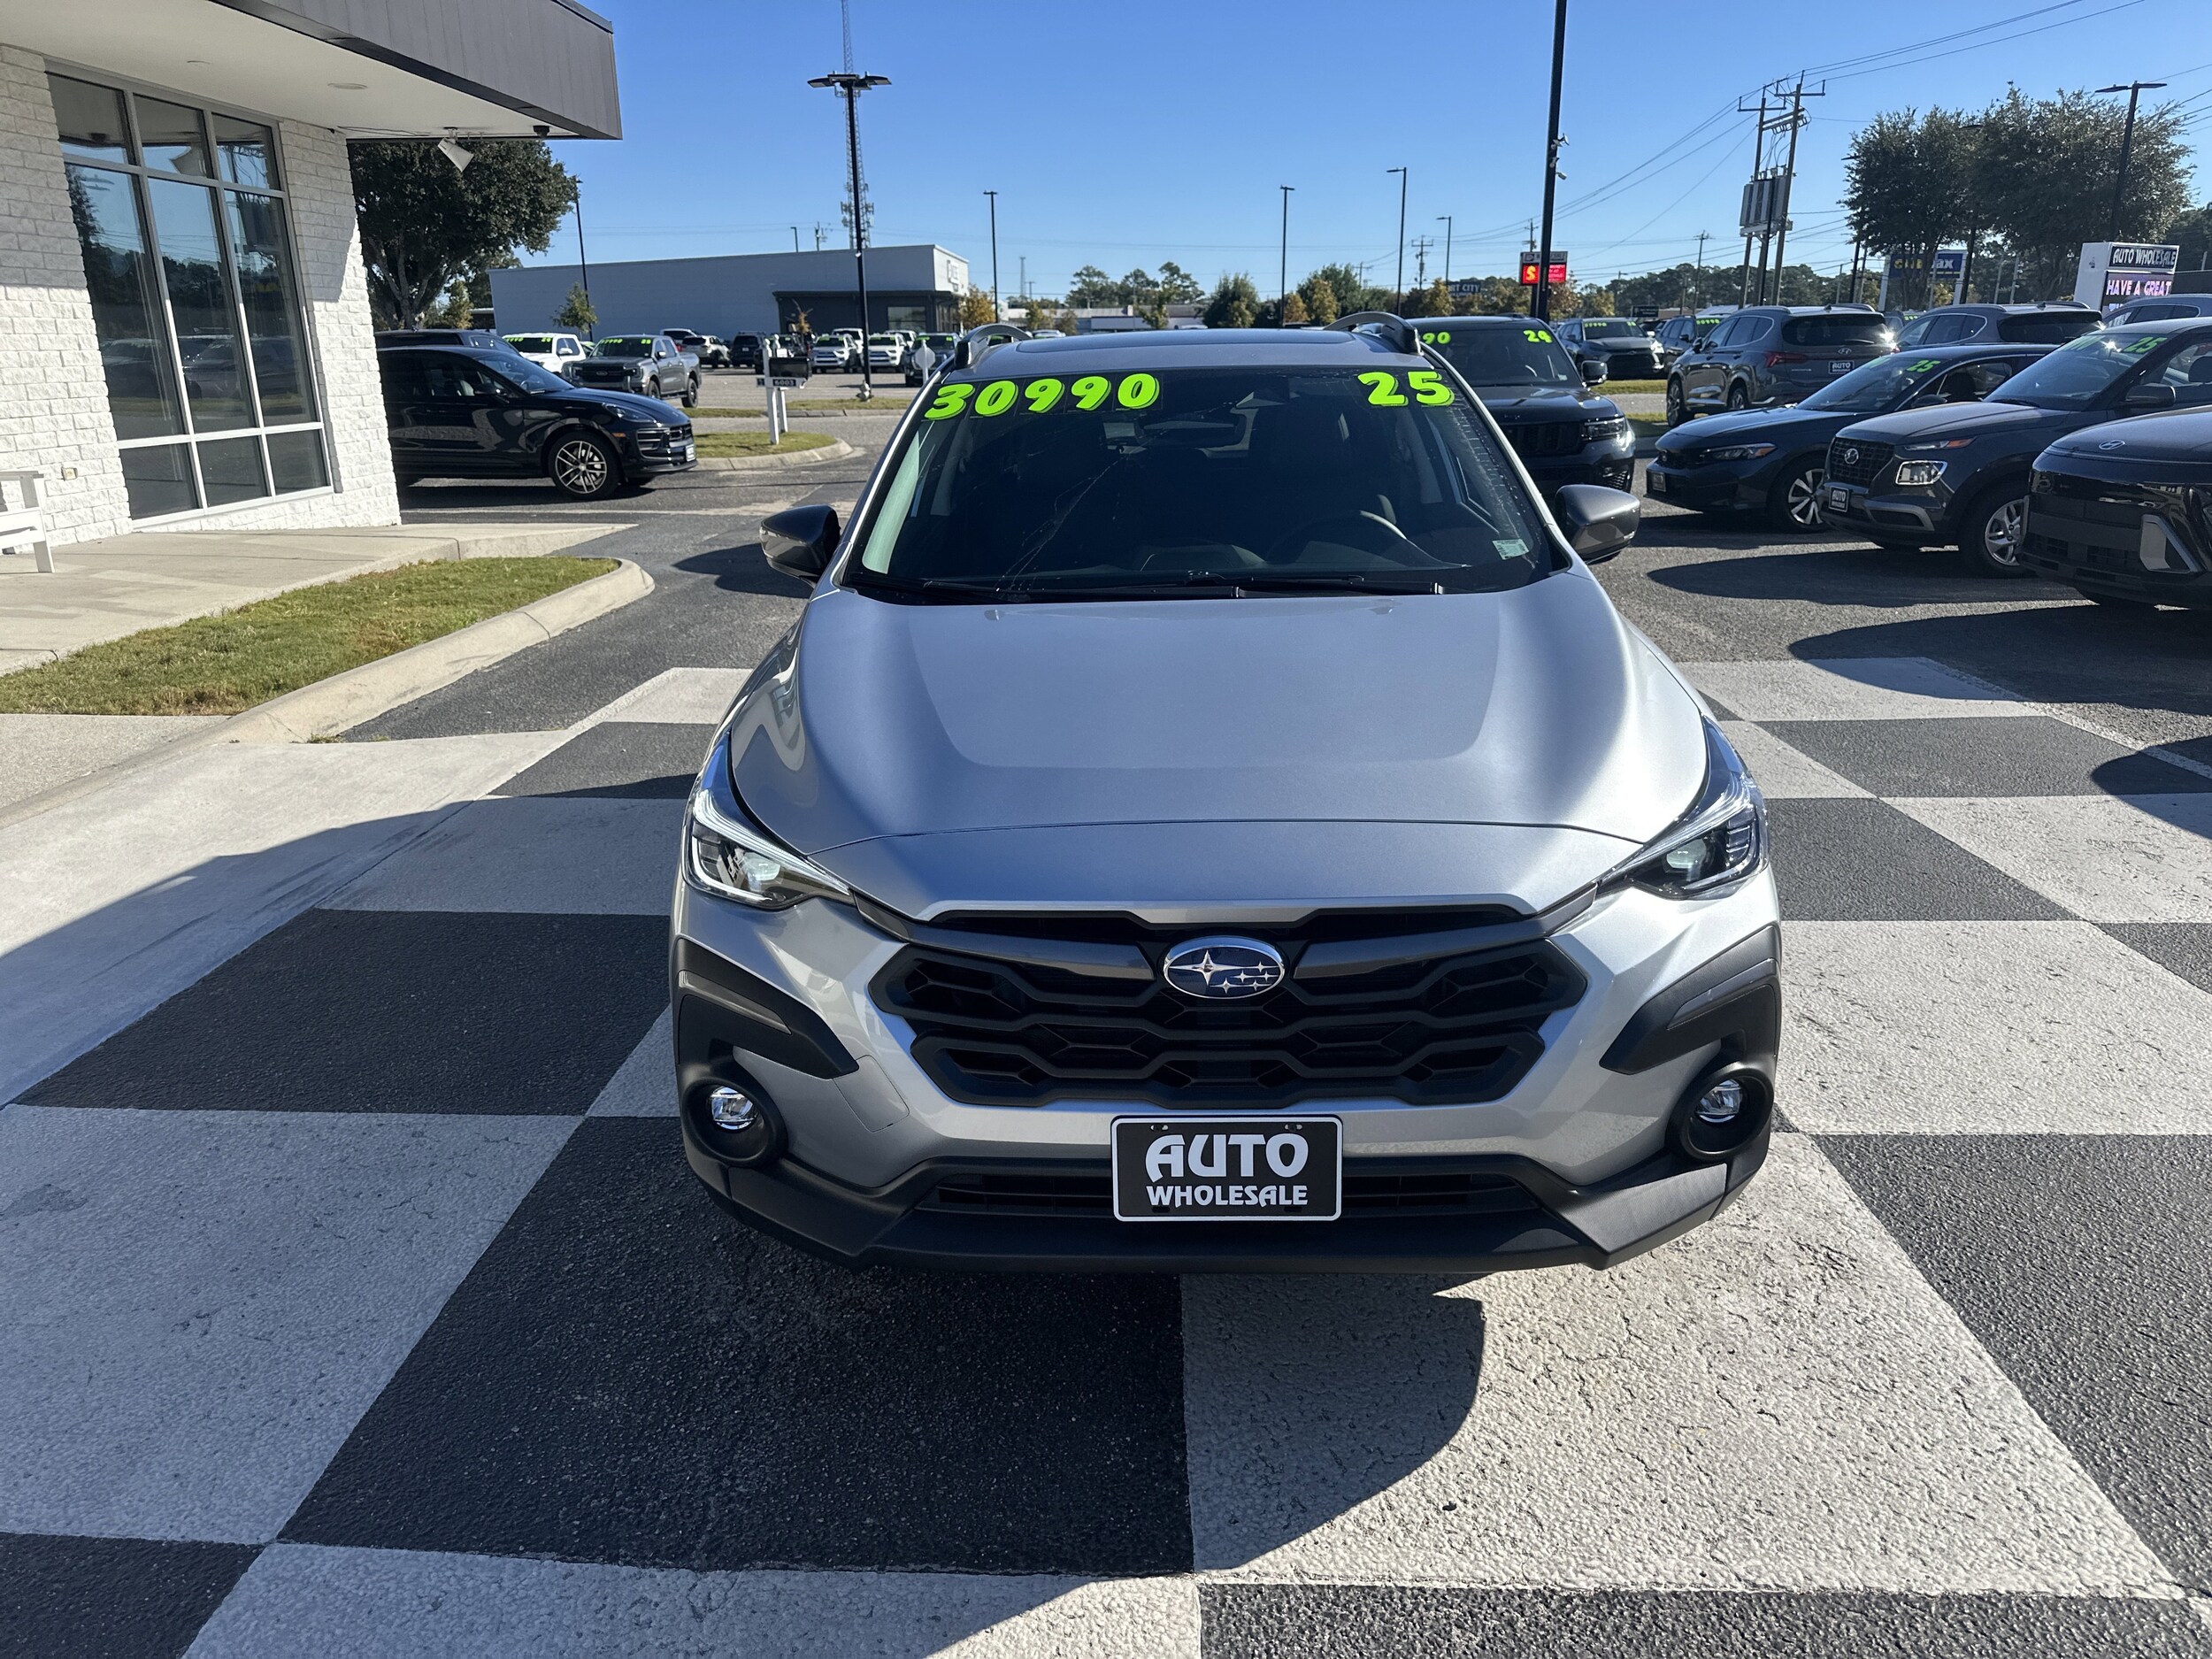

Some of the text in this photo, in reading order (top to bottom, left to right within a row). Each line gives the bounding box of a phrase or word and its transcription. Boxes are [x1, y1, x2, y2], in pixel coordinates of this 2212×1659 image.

[2112, 248, 2177, 266] AUTO WHOLESALE
[2106, 280, 2173, 296] HAVE A GREAT
[2125, 336, 2167, 353] 25
[1907, 359, 1940, 373] 25
[924, 371, 1455, 420] 30990 25
[1832, 489, 1847, 502] AUTO
[1145, 1133, 1310, 1183] AUTO
[1146, 1185, 1309, 1208] WHOLESALE
